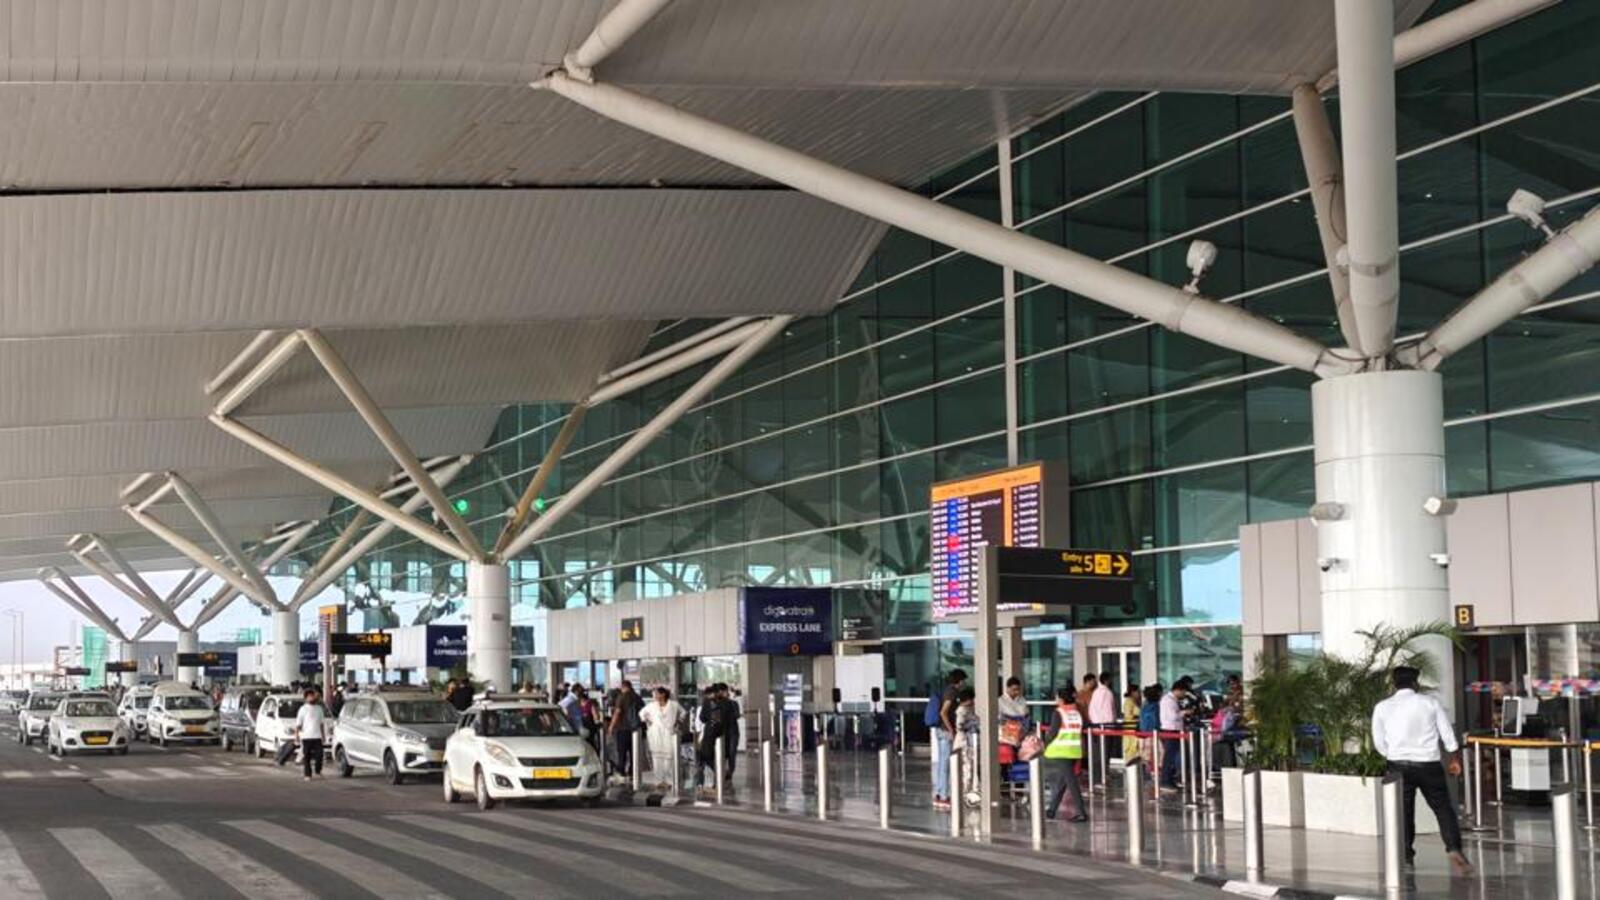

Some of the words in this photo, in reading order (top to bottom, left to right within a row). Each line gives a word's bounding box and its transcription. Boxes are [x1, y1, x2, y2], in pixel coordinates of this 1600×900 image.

[1061, 552, 1082, 564] Entry
[1084, 555, 1094, 572] 5
[1459, 607, 1470, 624] B
[759, 622, 798, 633] EXPRESS
[800, 622, 821, 633] LANE
